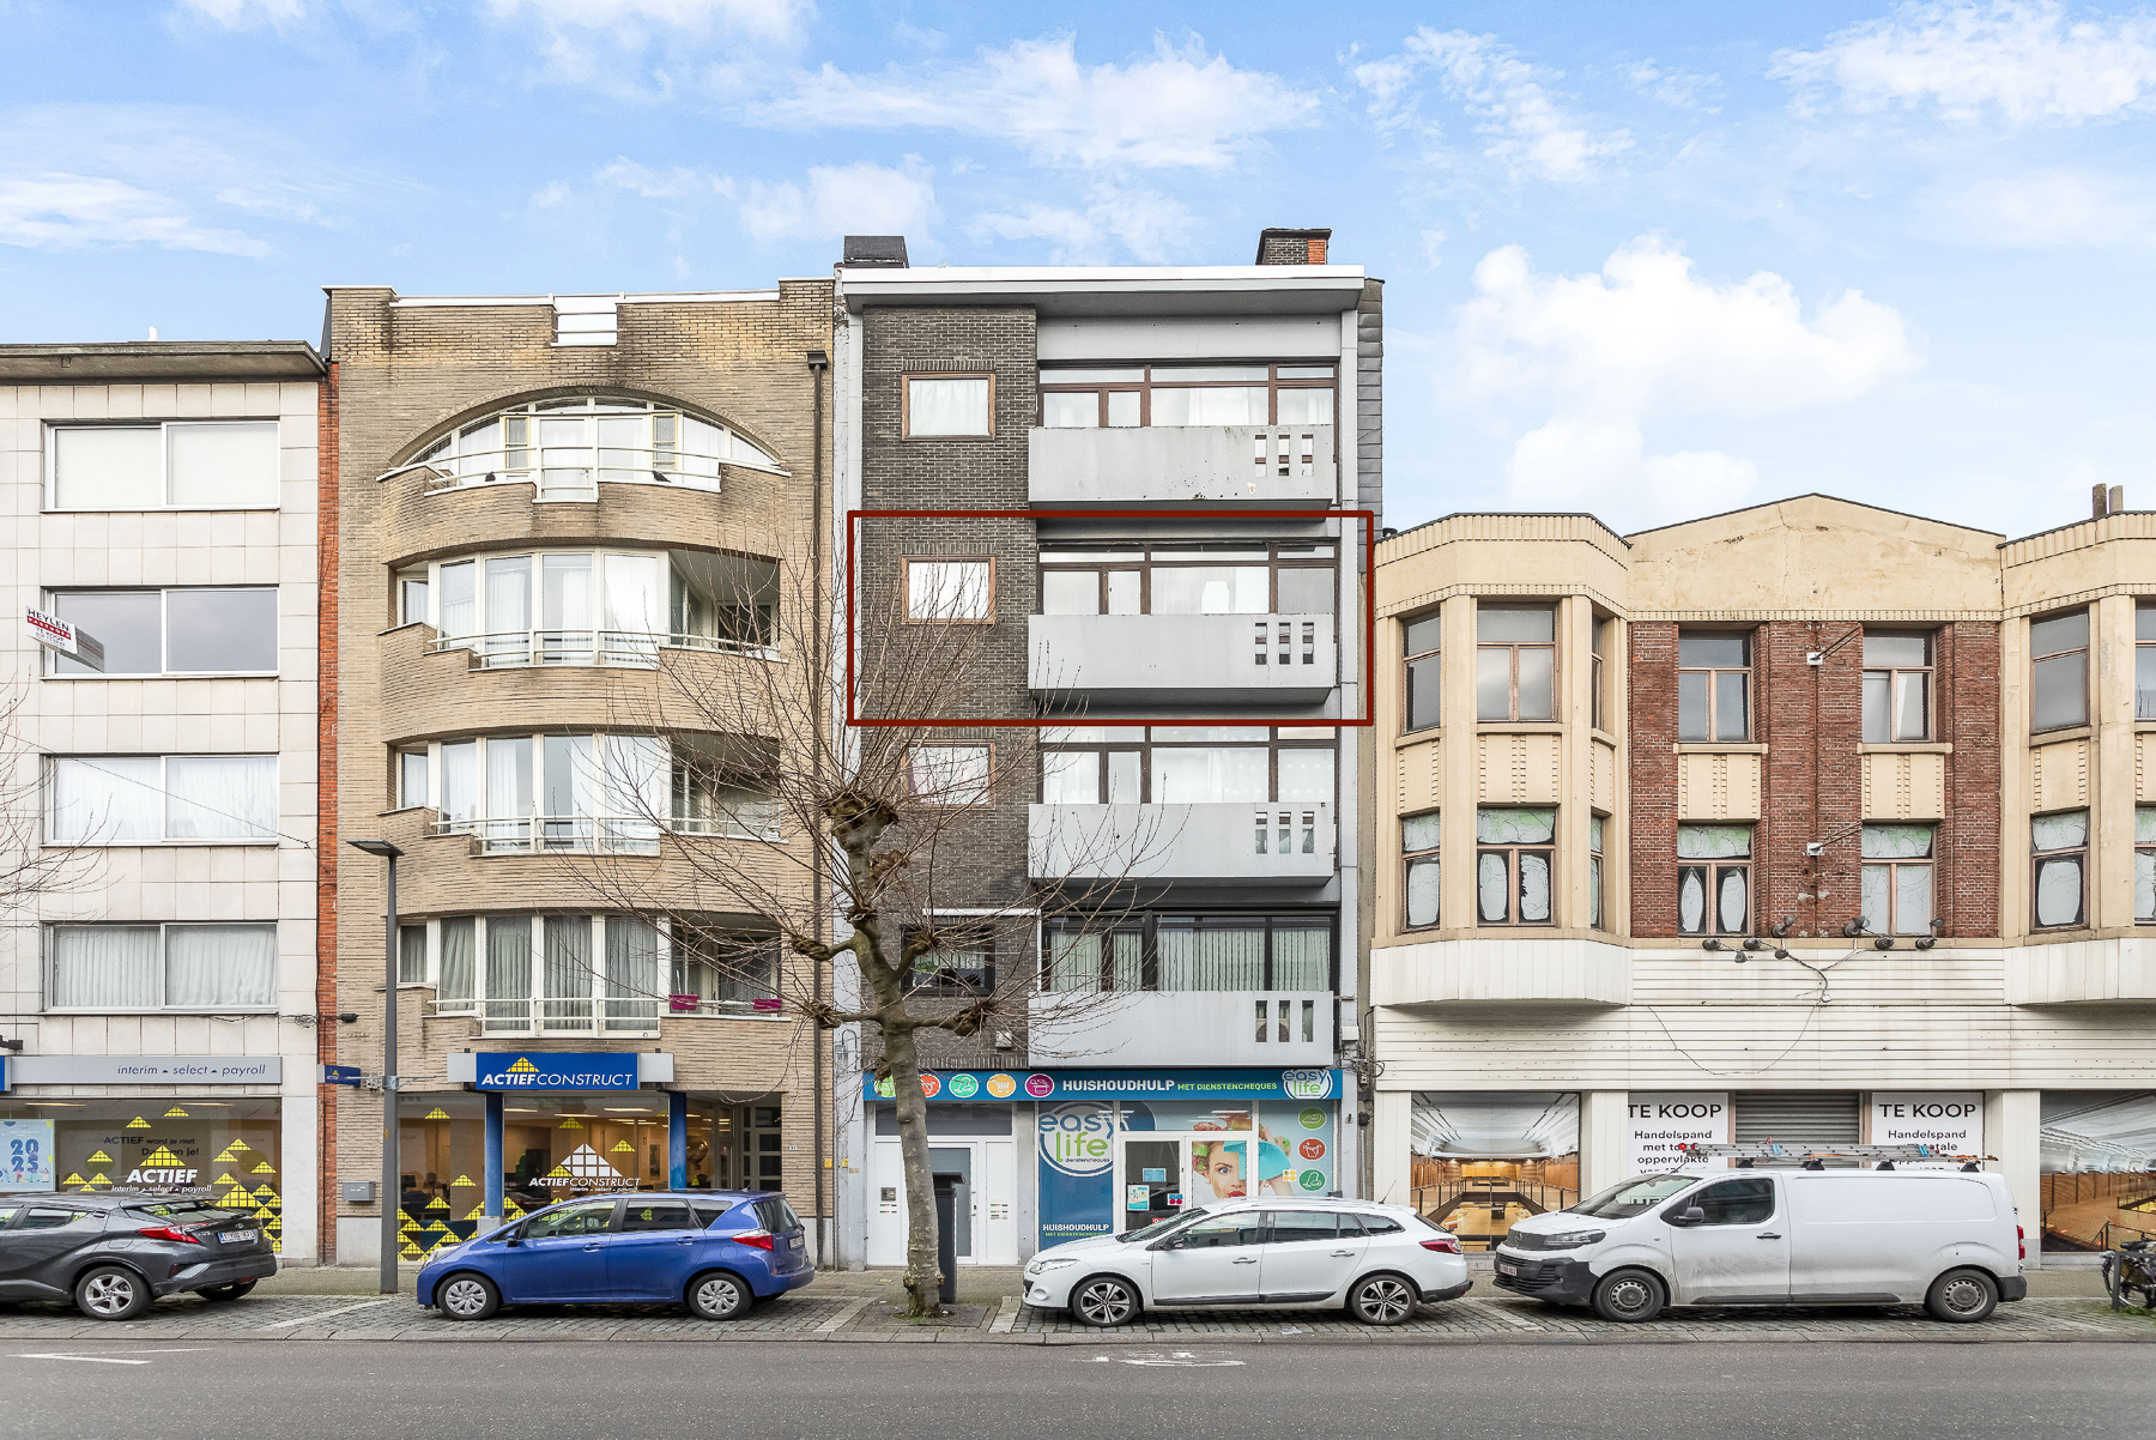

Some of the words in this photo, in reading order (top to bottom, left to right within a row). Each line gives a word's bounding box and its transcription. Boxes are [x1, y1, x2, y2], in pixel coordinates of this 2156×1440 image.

[28, 608, 69, 631] HEYLEN
[117, 1064, 158, 1075] interim
[173, 1064, 208, 1075] select
[222, 1063, 266, 1077] payroll
[1283, 1070, 1328, 1084] easy
[1062, 1080, 1175, 1091] HUISHOUDHULP
[1197, 1082, 1278, 1091] DIENSTENCHEQUES
[1293, 1080, 1321, 1097] life
[1628, 1104, 1651, 1118] TE
[1658, 1104, 1722, 1118] KOOP
[1879, 1104, 1905, 1118] TE
[1912, 1103, 1976, 1118] KOOP
[103, 1136, 144, 1145] ACTIEF
[146, 1137, 168, 1145] word
[169, 1138, 178, 1146] je
[179, 1137, 195, 1145] niet
[1634, 1130, 1712, 1140] Handelspand
[1888, 1130, 1966, 1140] Handelspand
[10, 1138, 39, 1155] 20
[1056, 1131, 1108, 1162] life
[1643, 1143, 1666, 1151] met
[1637, 1154, 1709, 1165] oppervlakte
[125, 1168, 198, 1184] ACTIEF
[111, 1184, 140, 1193] interim
[149, 1184, 174, 1193] select
[181, 1184, 212, 1194] payroll
